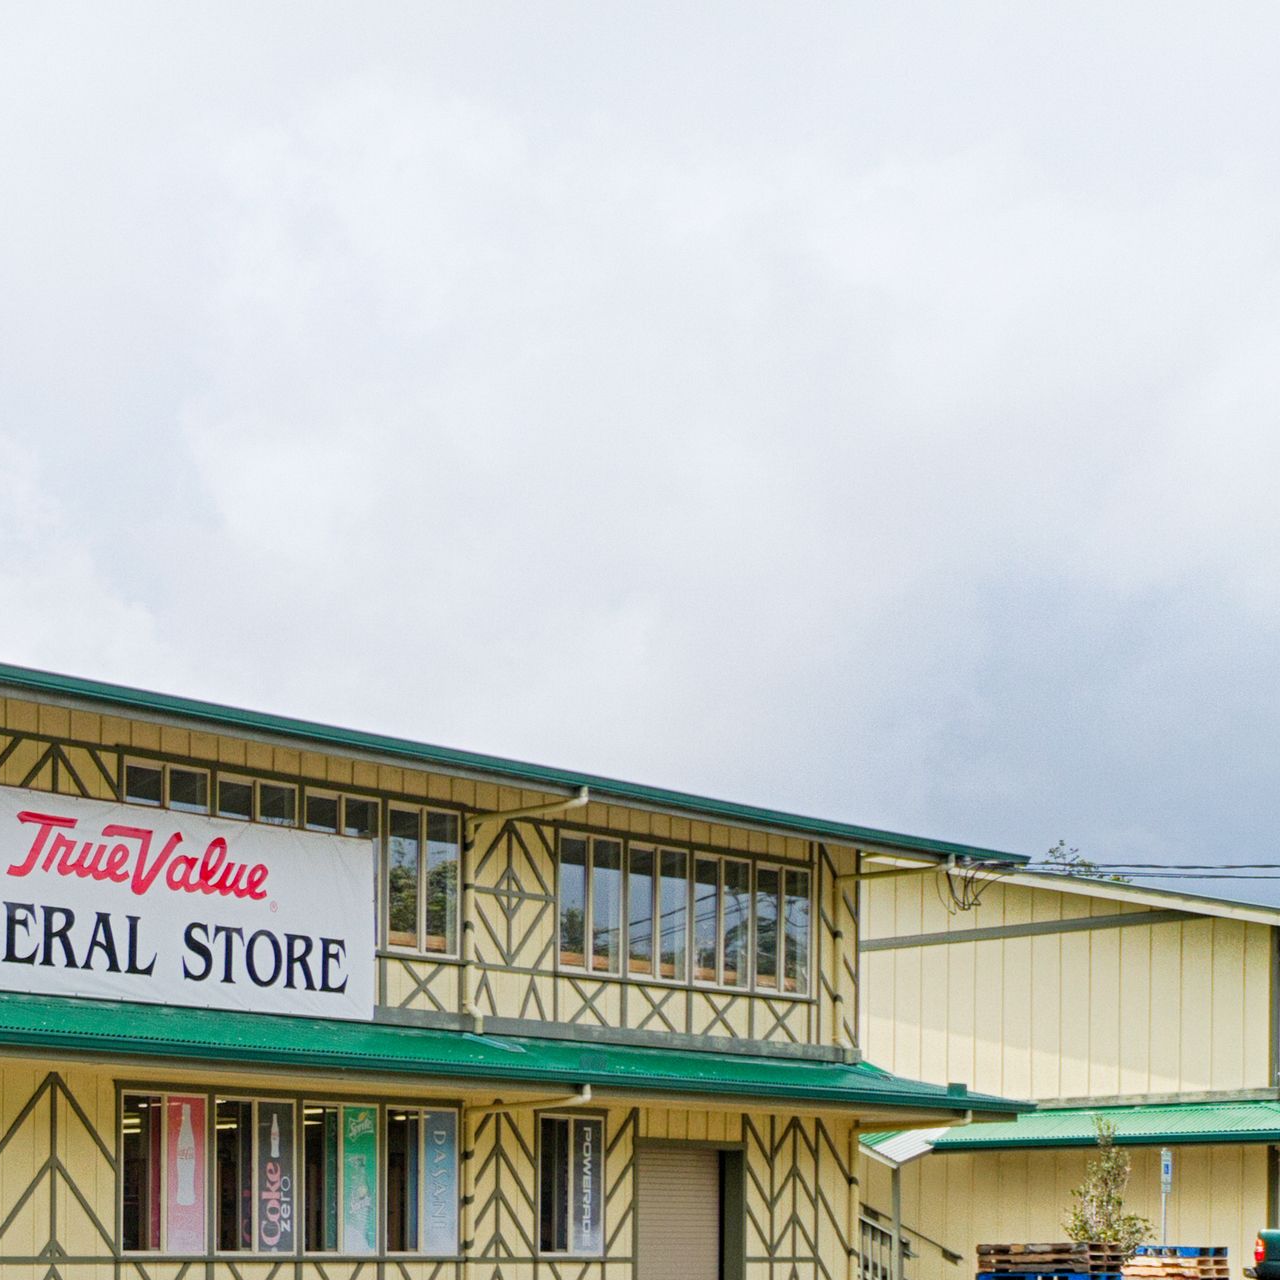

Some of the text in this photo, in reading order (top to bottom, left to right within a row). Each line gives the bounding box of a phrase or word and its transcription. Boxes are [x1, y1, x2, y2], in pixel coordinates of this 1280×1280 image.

[183, 921, 350, 994] STORE
[261, 1162, 281, 1246] Coke
[281, 1176, 291, 1233] zero
[431, 1130, 447, 1229] DASANI
[583, 1126, 592, 1247] POWERADE
